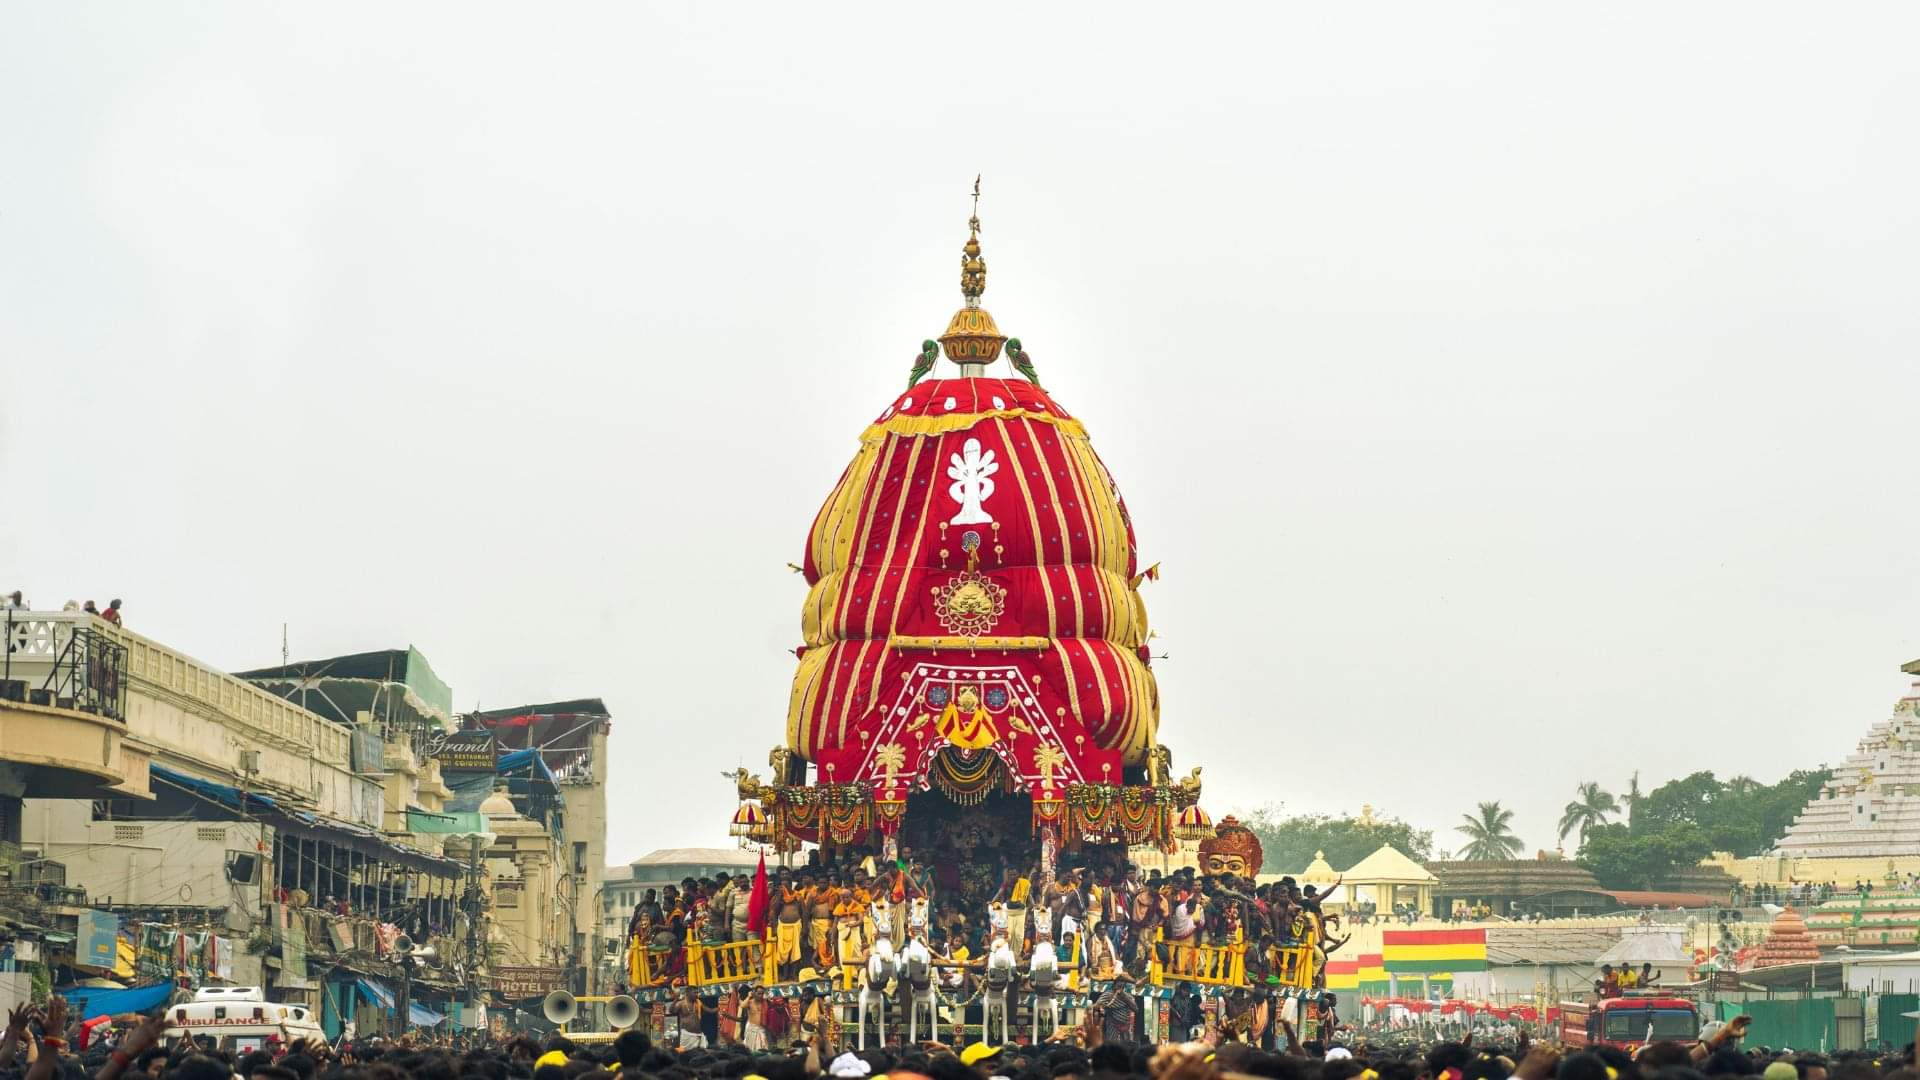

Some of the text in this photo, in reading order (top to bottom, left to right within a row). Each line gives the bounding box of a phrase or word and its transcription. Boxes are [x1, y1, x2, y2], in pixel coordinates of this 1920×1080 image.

[426, 733, 492, 755] Grand
[499, 981, 545, 992] HOTEL
[176, 1017, 272, 1026] MBULANCE
